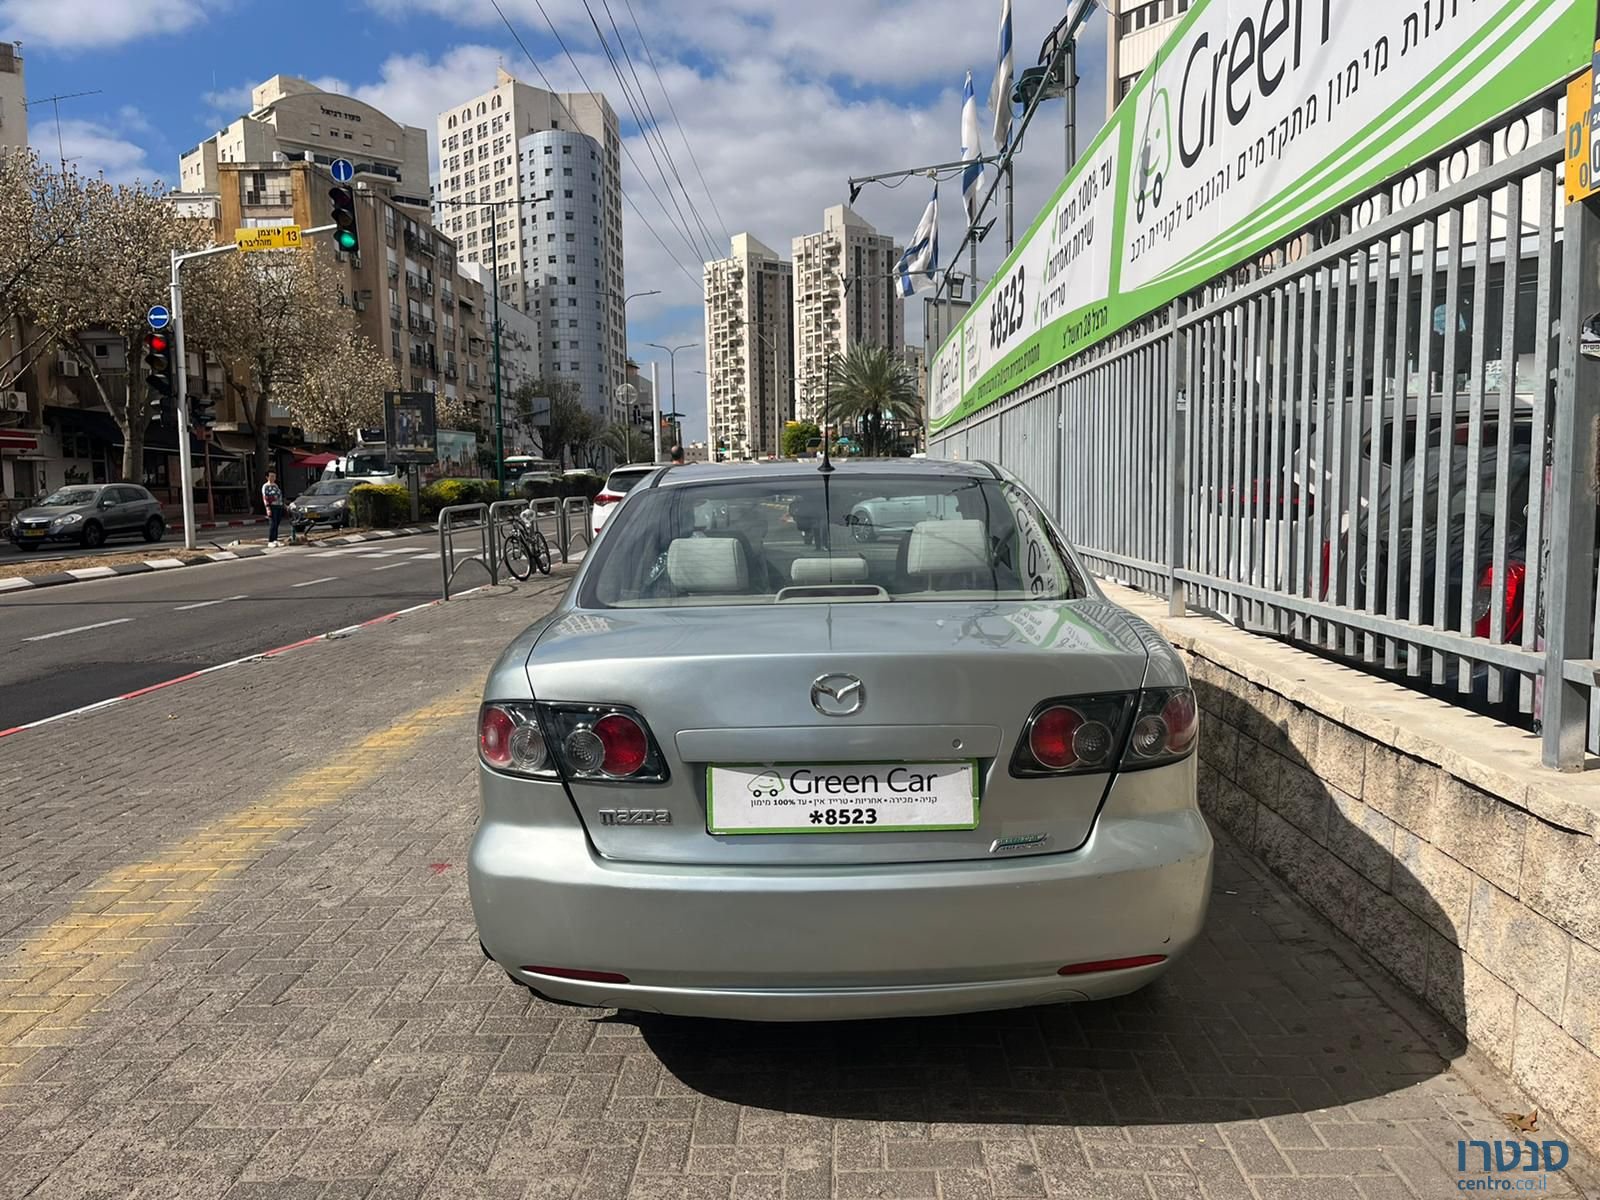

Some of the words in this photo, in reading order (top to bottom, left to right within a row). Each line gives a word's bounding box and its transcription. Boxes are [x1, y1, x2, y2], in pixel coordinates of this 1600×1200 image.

[1327, 35, 1389, 122] מימון
[1237, 93, 1317, 181] מתקדמים
[1100, 155, 1112, 191] עד
[1078, 170, 1098, 212] 100%
[1186, 163, 1231, 221] והוגנים
[257, 229, 276, 238] ויצמן
[286, 230, 298, 242] 13
[1058, 198, 1076, 245] מימון
[1148, 200, 1182, 249] לקניית
[1072, 216, 1094, 260] שירות
[1130, 234, 1145, 263] רכב
[1040, 298, 1049, 329] אין
[1050, 281, 1066, 314] טרייד
[789, 769, 878, 795] Green
[887, 767, 938, 793] Car
[750, 799, 771, 808] מימון
[813, 799, 826, 807] אין
[889, 796, 914, 804] מכירה
[919, 796, 938, 804] קניה
